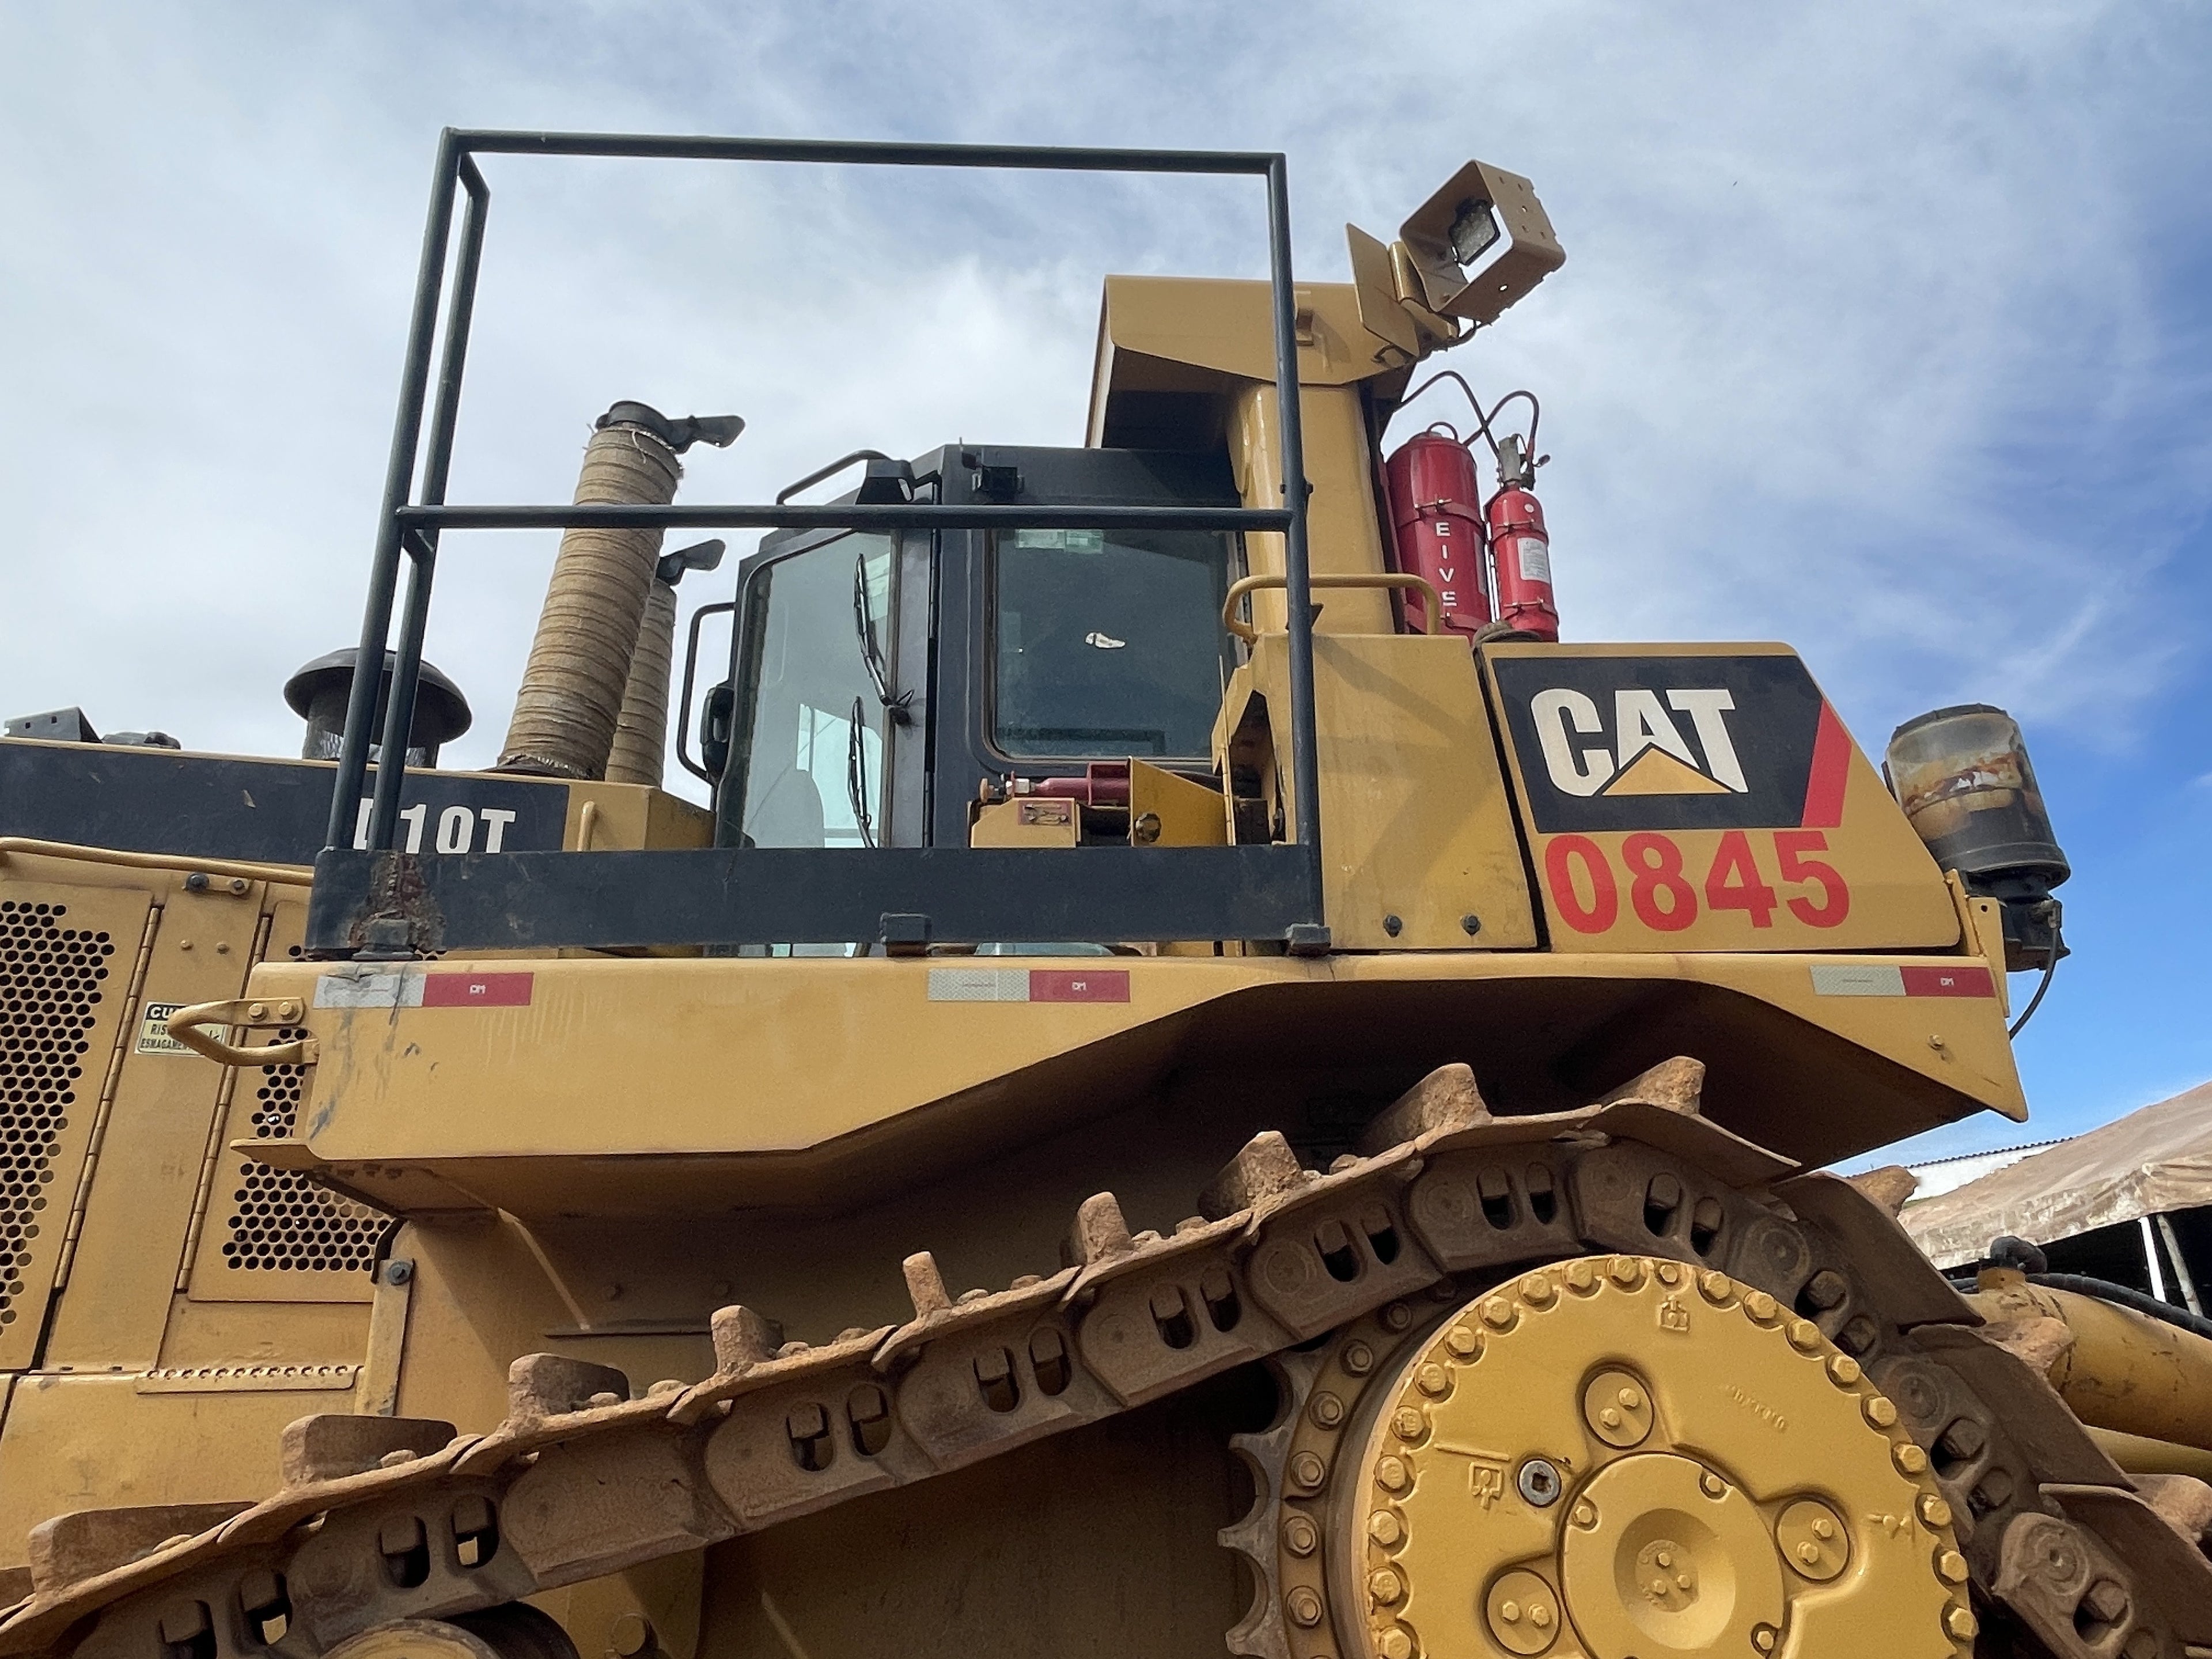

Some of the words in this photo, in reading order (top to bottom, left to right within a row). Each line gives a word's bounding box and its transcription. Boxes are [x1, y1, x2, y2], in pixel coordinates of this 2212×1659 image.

[1530, 688, 1749, 797] CAT
[1544, 831, 1850, 934] 0845
[150, 1024, 168, 1036] RIS
